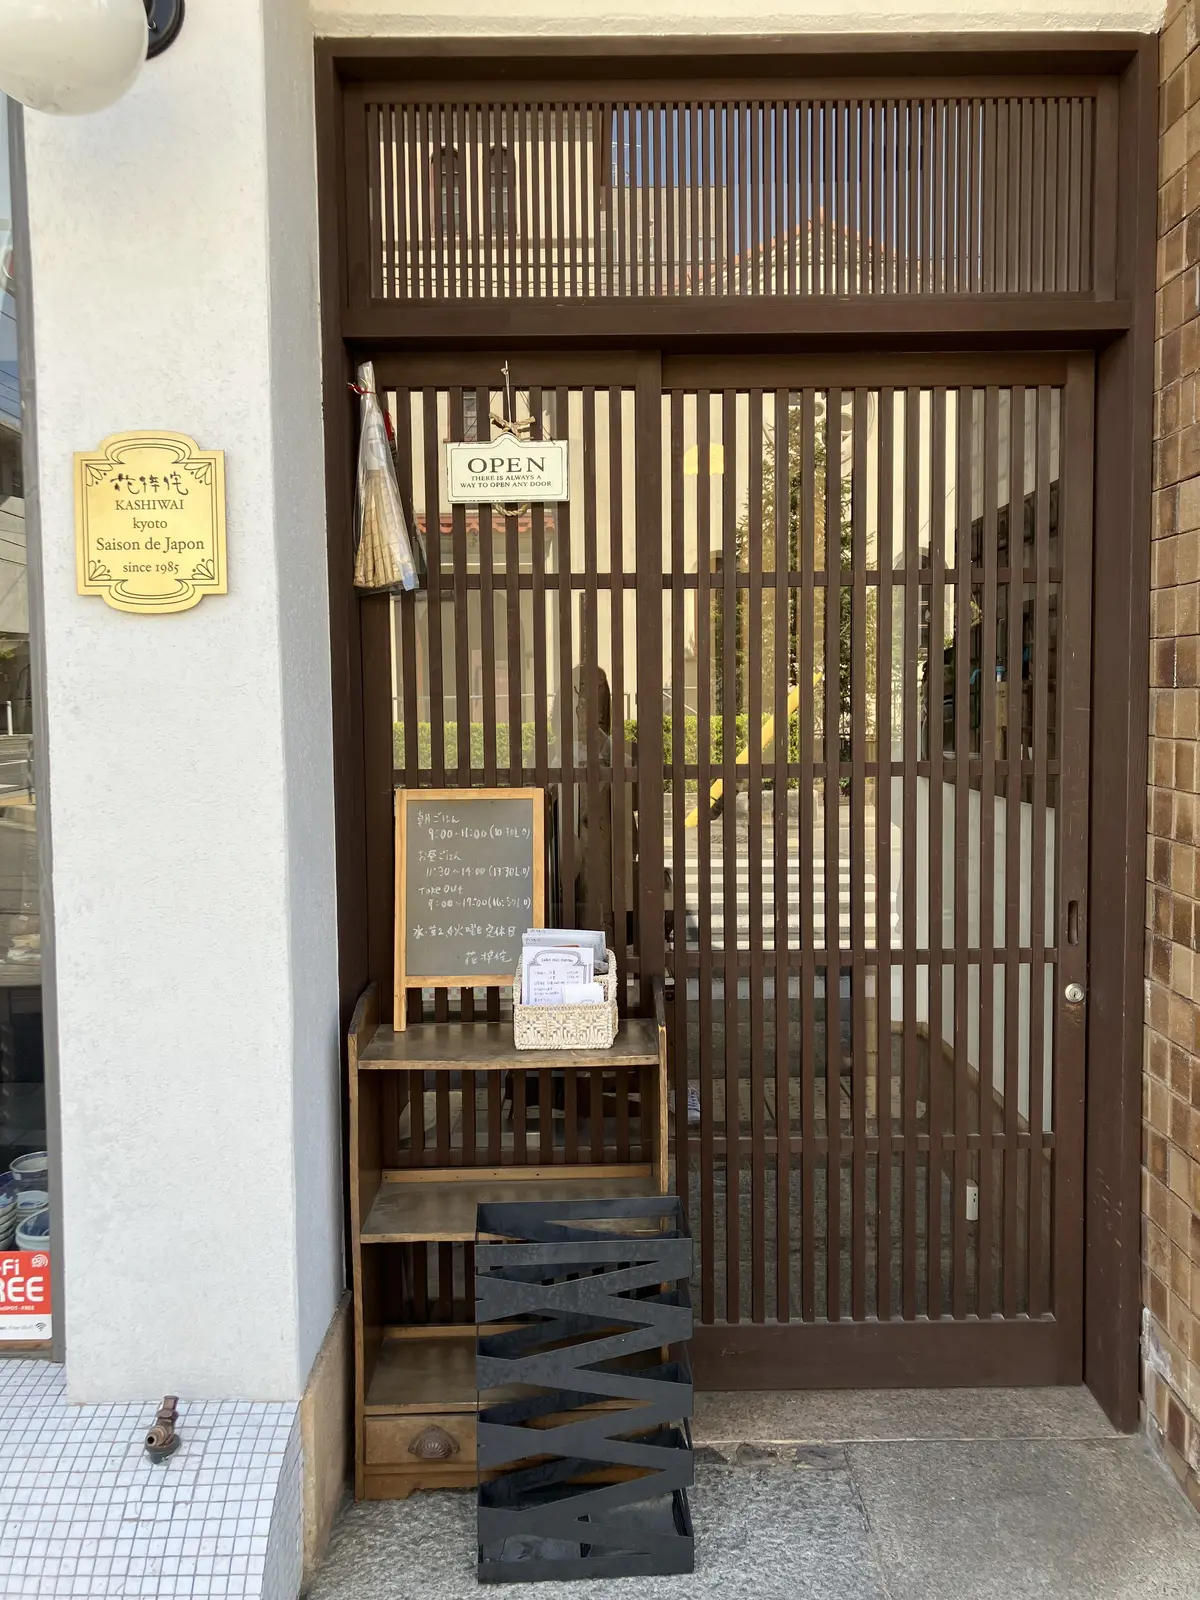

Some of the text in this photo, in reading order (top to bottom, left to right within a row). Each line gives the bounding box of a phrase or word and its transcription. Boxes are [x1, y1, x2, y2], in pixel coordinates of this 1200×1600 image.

[467, 457, 546, 473] OPEN
[115, 499, 184, 511] KASHIWAI
[132, 518, 168, 532] kyoto
[96, 537, 205, 553] Saison de Japon
[122, 561, 180, 574] since 1985
[416, 810, 460, 827] 朝ごはん
[417, 849, 462, 862] お昼ごはん
[418, 885, 464, 895] Take Out
